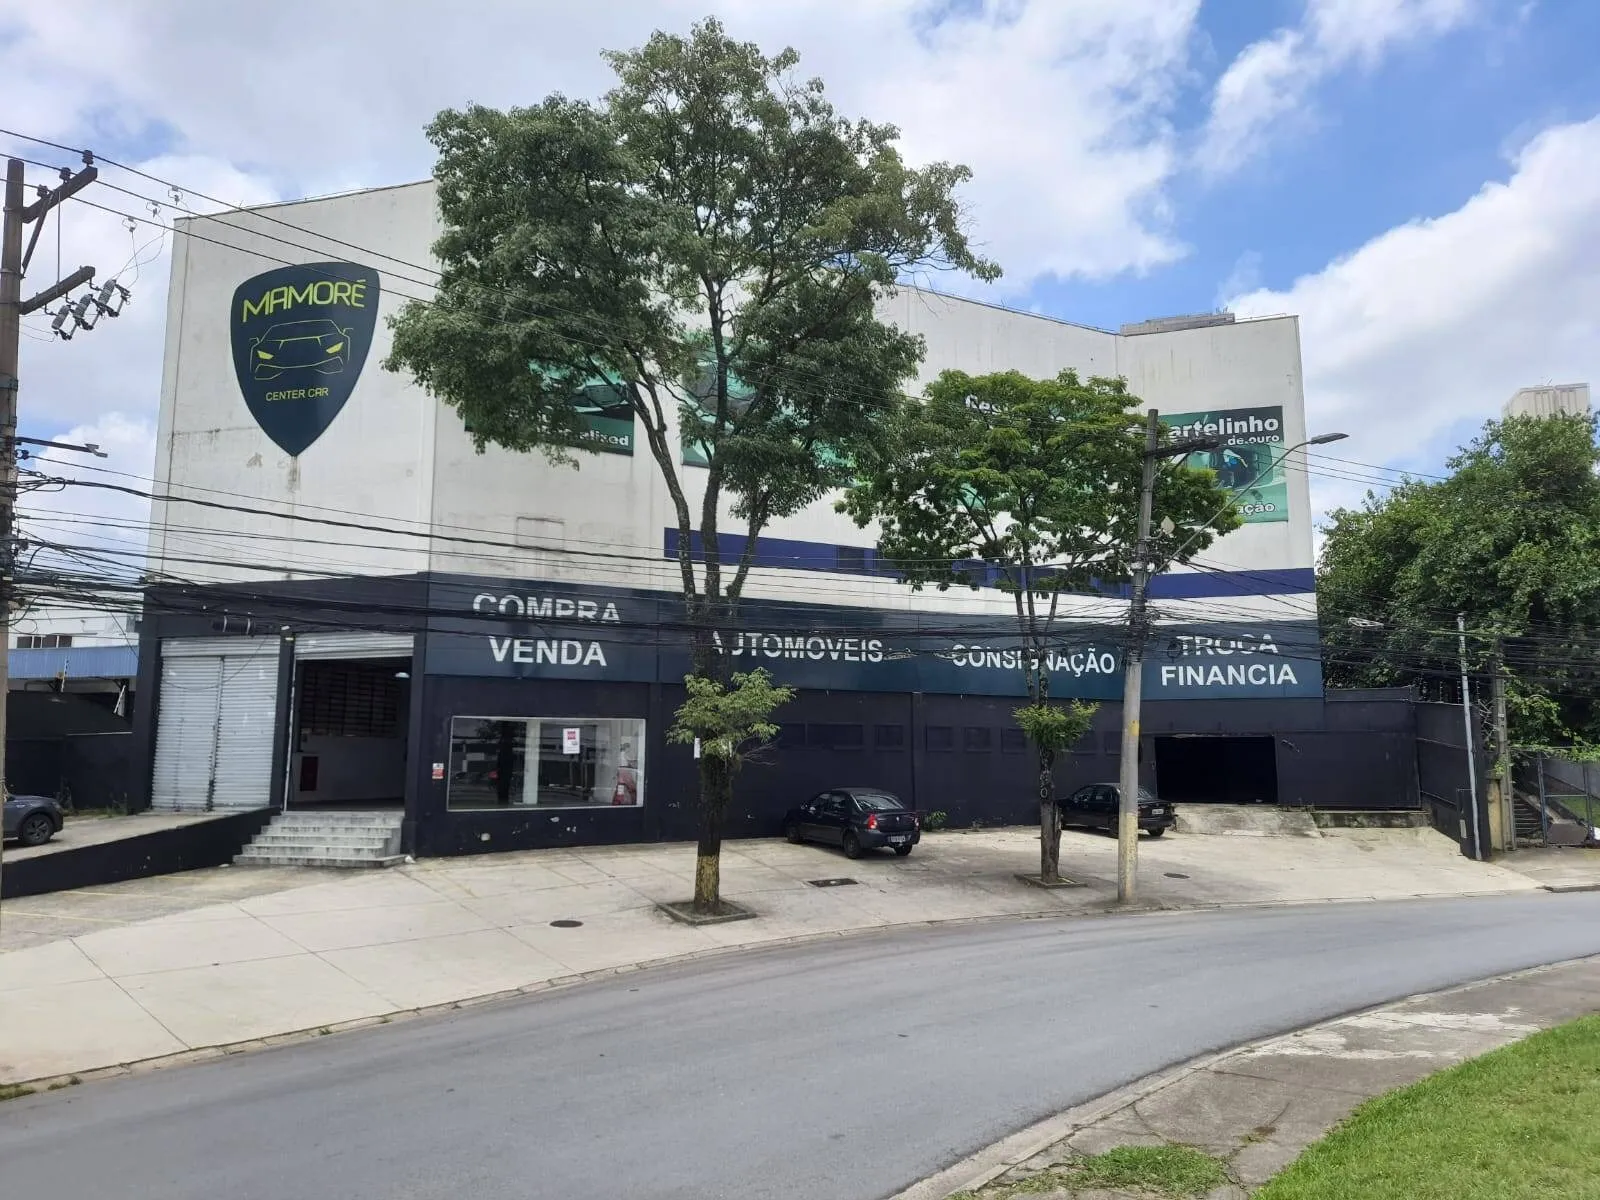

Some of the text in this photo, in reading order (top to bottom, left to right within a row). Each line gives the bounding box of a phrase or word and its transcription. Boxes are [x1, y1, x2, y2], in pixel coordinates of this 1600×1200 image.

[243, 279, 366, 323] MAMORÉ
[265, 387, 329, 402] CENTER CAR
[1167, 415, 1279, 439] artelinho
[1228, 434, 1280, 446] de ouro
[472, 592, 621, 624] COMPRA
[488, 635, 608, 667] VENDA
[1175, 633, 1279, 656] TROCA
[1160, 663, 1298, 687] FINANCIA
